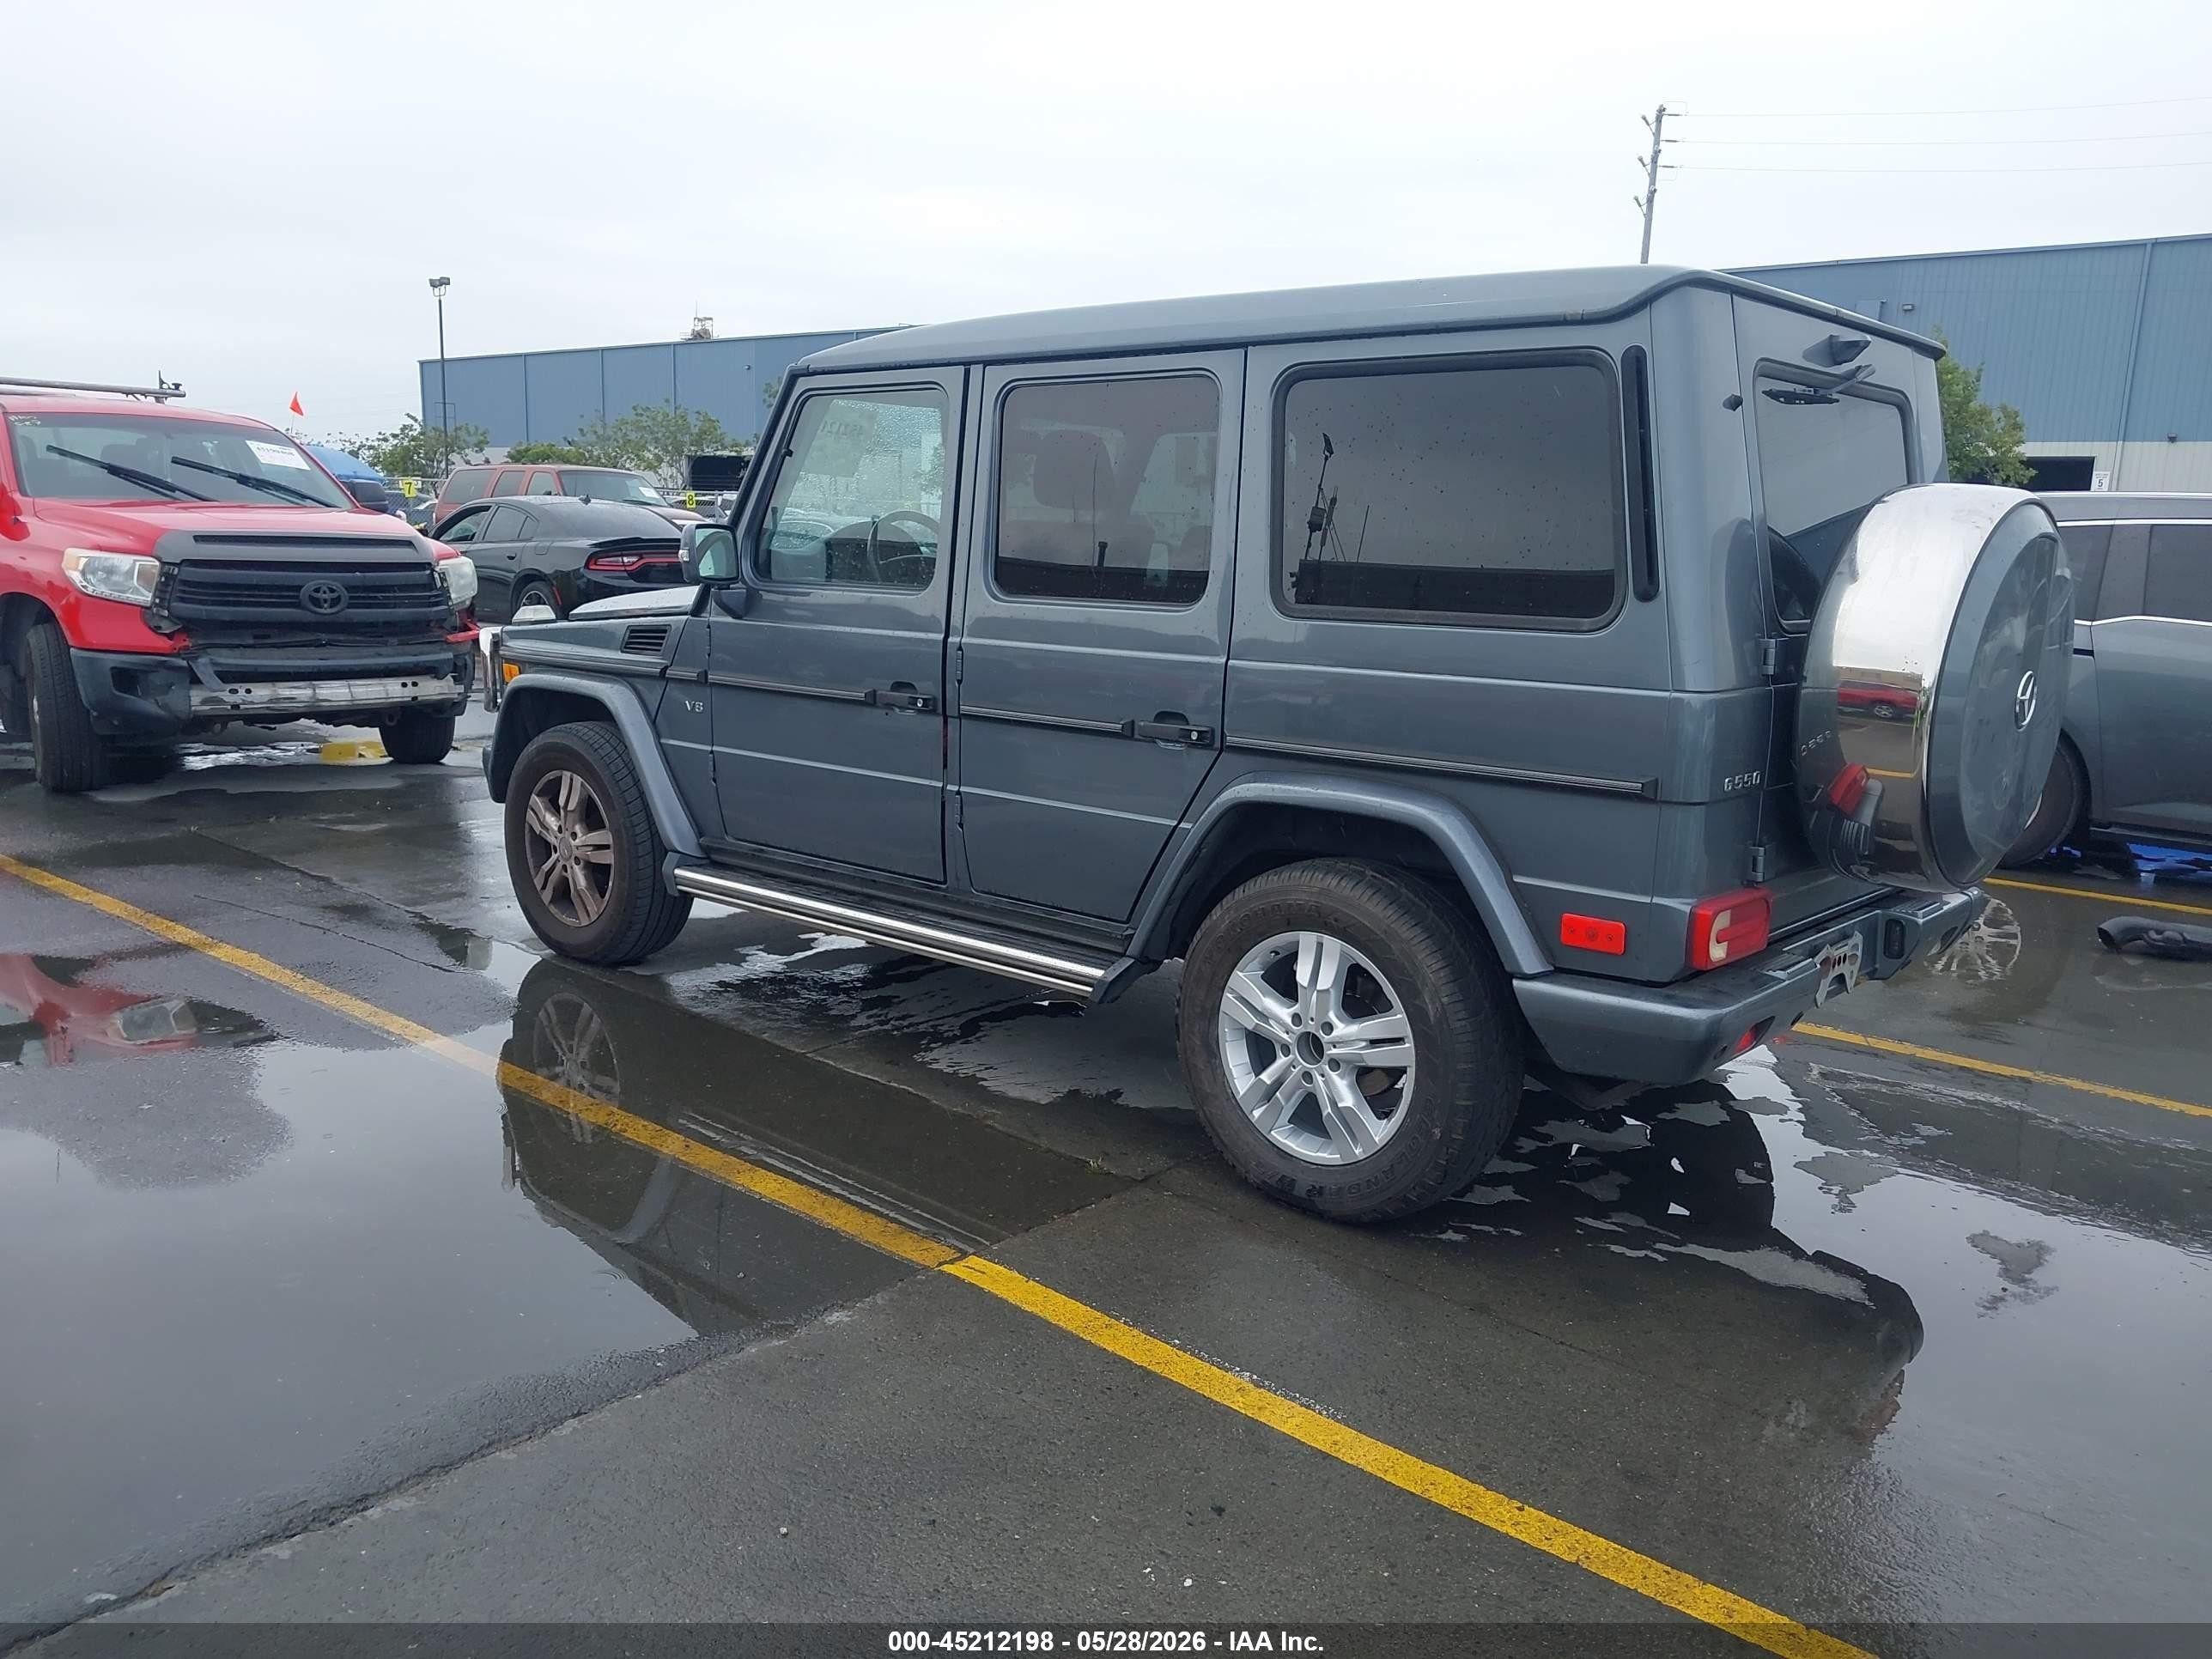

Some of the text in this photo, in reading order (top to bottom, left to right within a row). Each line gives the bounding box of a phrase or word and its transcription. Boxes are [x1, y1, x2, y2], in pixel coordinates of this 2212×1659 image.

[404, 482, 412, 495] 7
[2098, 478, 2104, 488] 5
[688, 495, 695, 506] 8
[685, 700, 703, 713] V8
[1723, 770, 1761, 792] G550
